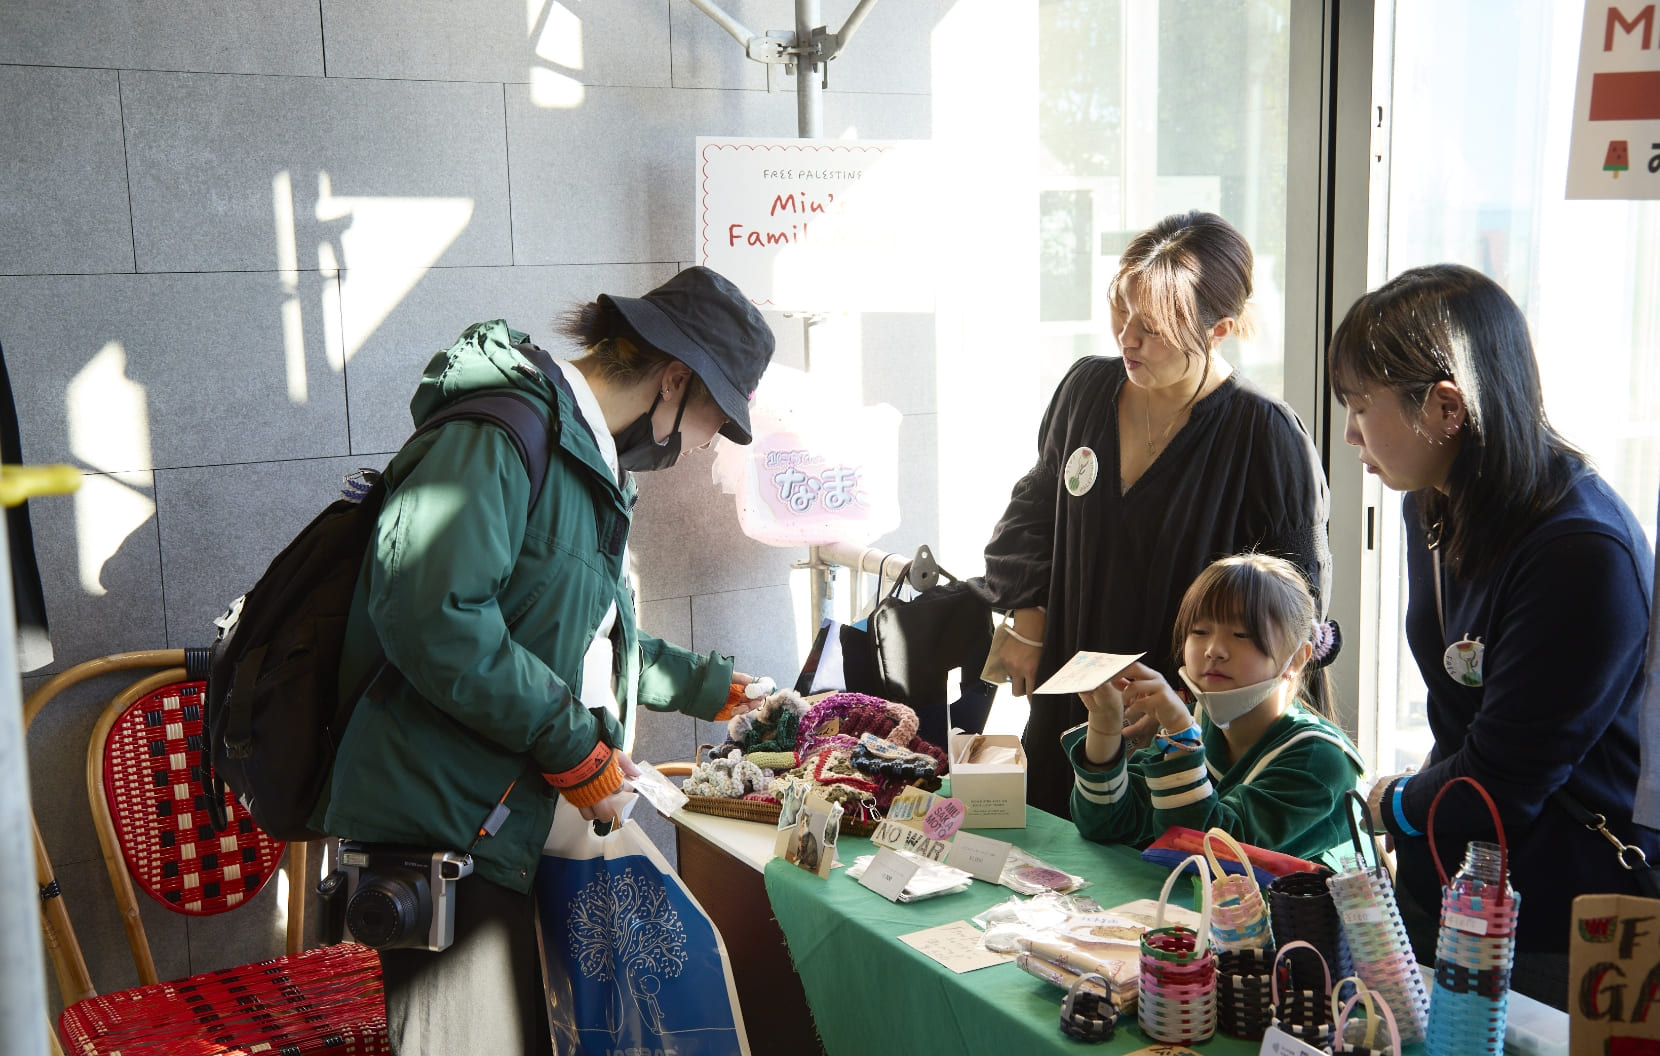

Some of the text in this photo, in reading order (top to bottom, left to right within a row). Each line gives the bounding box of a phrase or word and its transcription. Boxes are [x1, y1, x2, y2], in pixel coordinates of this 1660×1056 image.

[1603, 5, 1660, 52] M
[763, 169, 863, 181] FREE PALESTINE
[934, 807, 954, 831] SAKA
[944, 801, 961, 819] MIU
[926, 815, 947, 838] MOTO
[876, 821, 902, 843] NO
[904, 830, 944, 861] WAR
[1619, 915, 1660, 960] F
